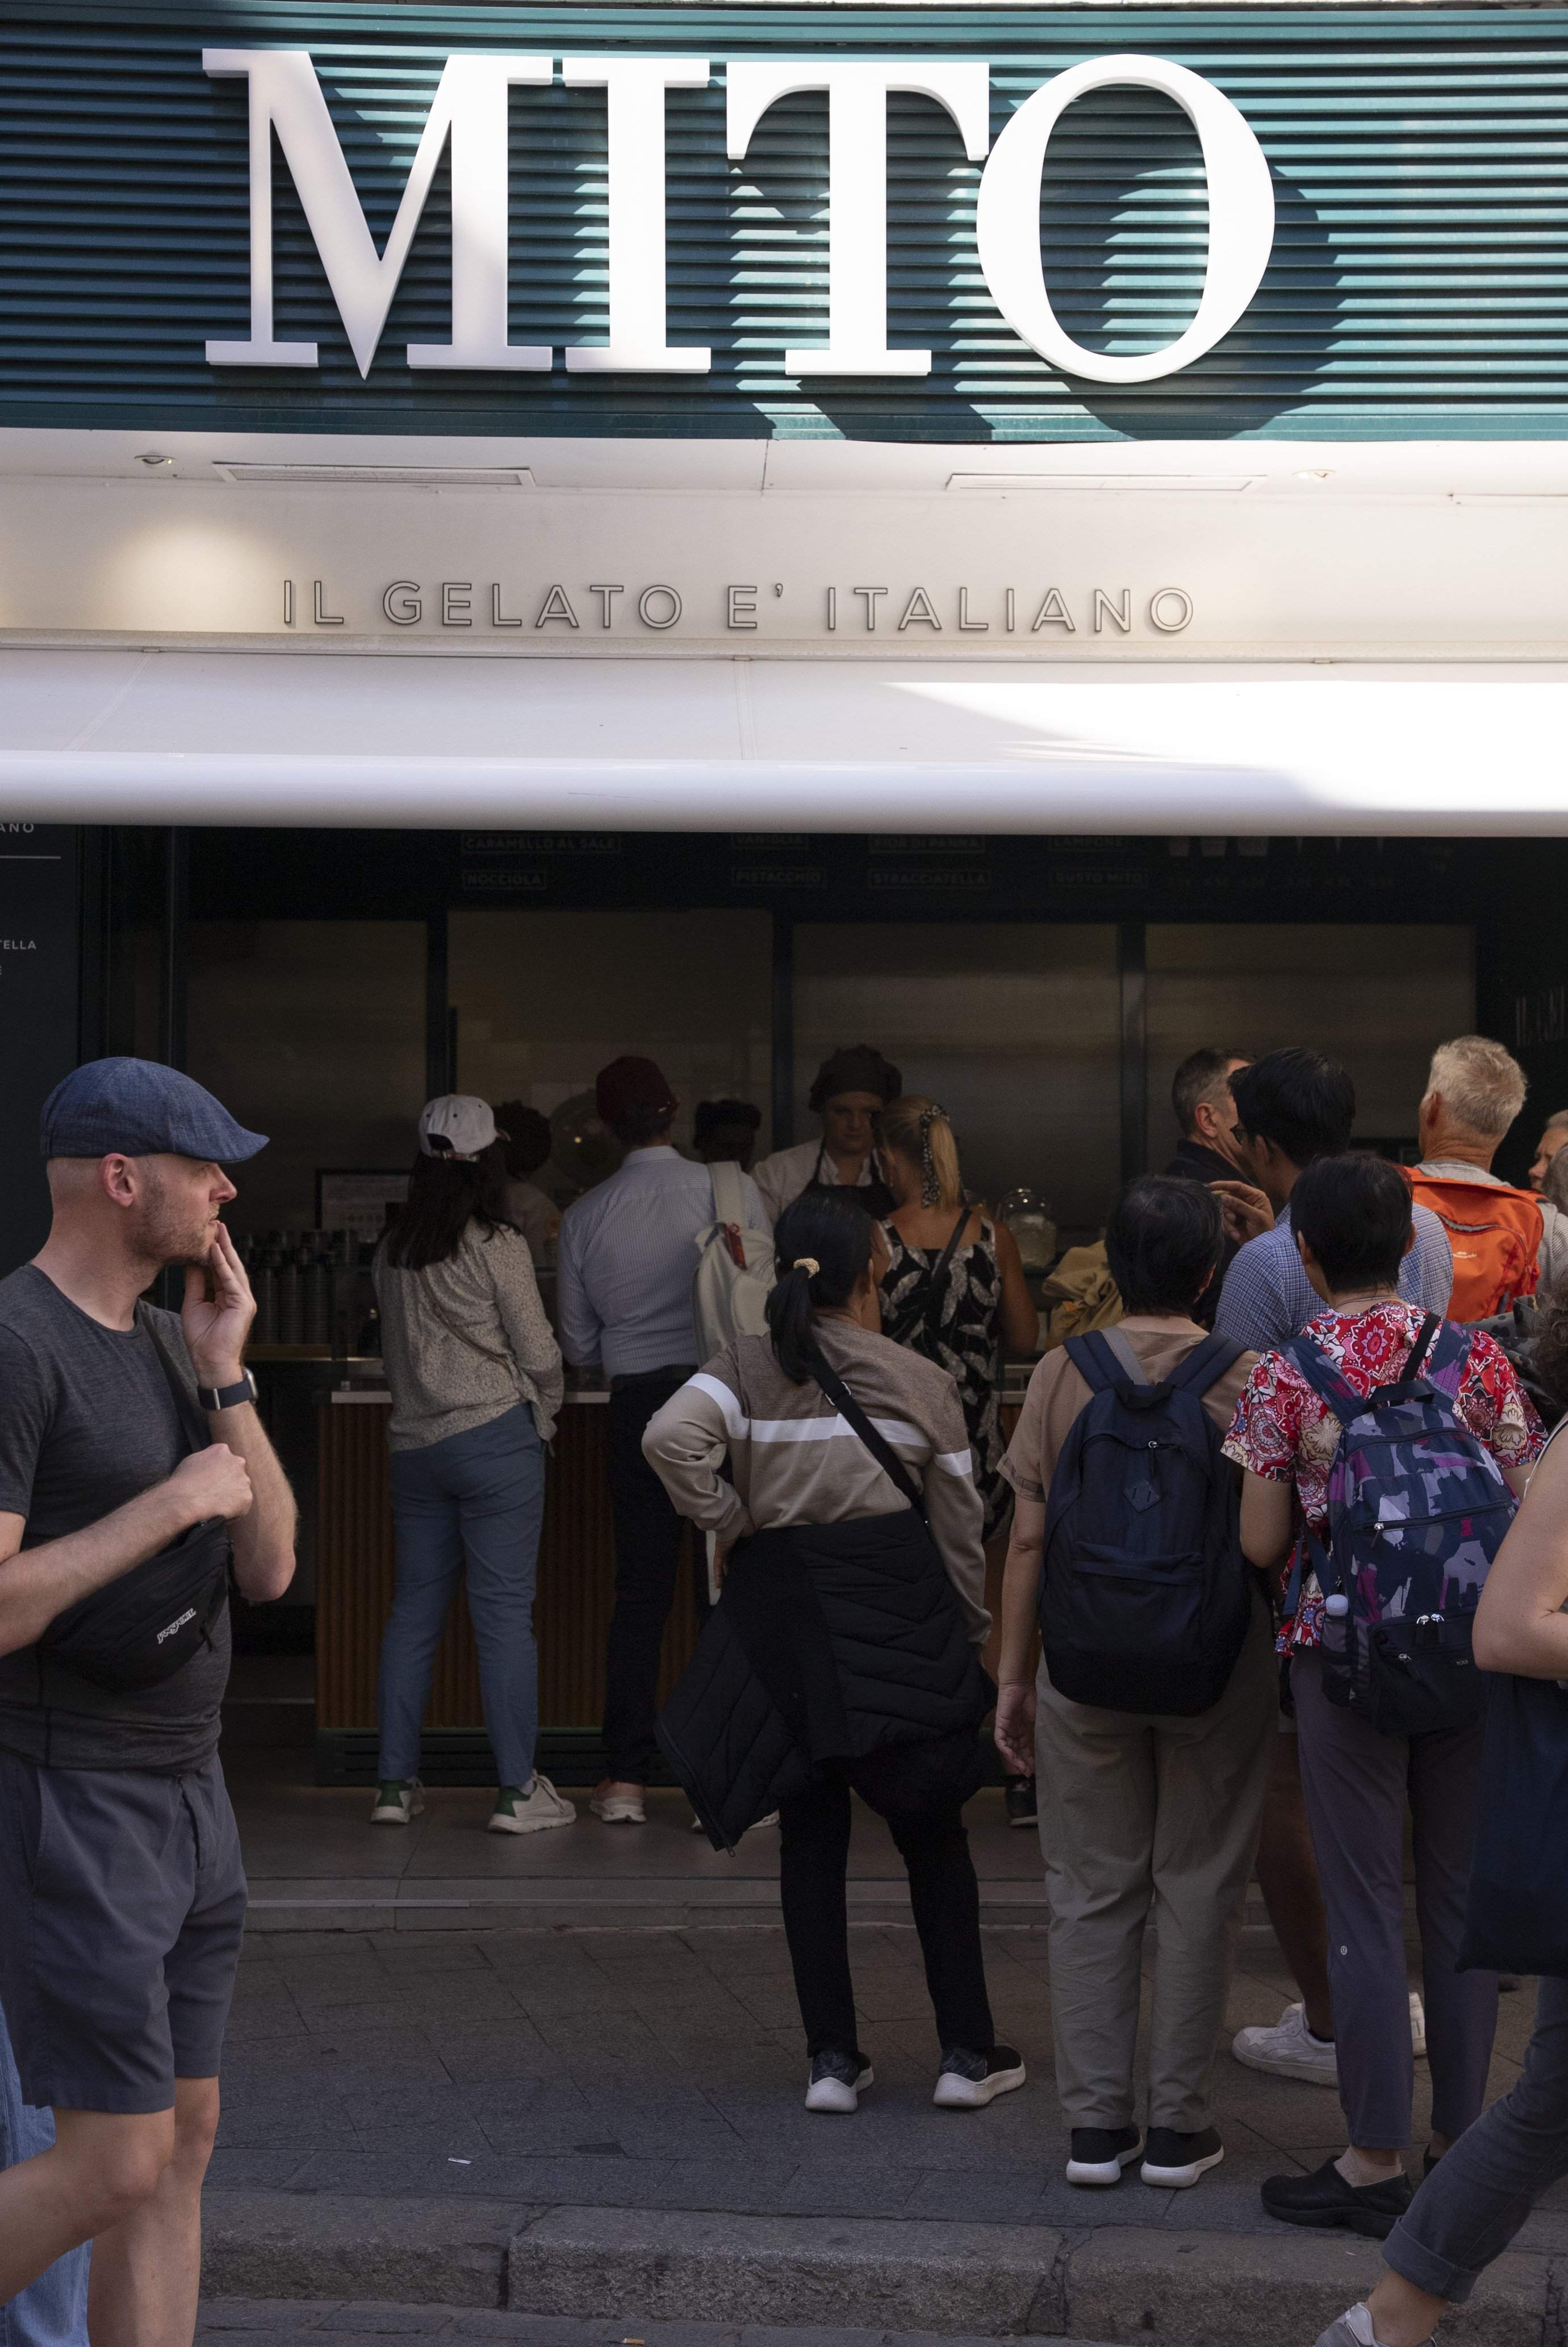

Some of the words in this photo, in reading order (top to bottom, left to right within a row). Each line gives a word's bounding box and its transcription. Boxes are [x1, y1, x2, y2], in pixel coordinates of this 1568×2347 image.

[202, 48, 1276, 383] MITO
[283, 580, 344, 624] IL
[382, 580, 682, 629] GELATO
[827, 587, 1194, 631] ITALIANO
[466, 838, 553, 849] CARAMELLO
[558, 838, 575, 848] AL
[579, 838, 614, 848] SALE
[467, 874, 541, 885] NOCCIOLA
